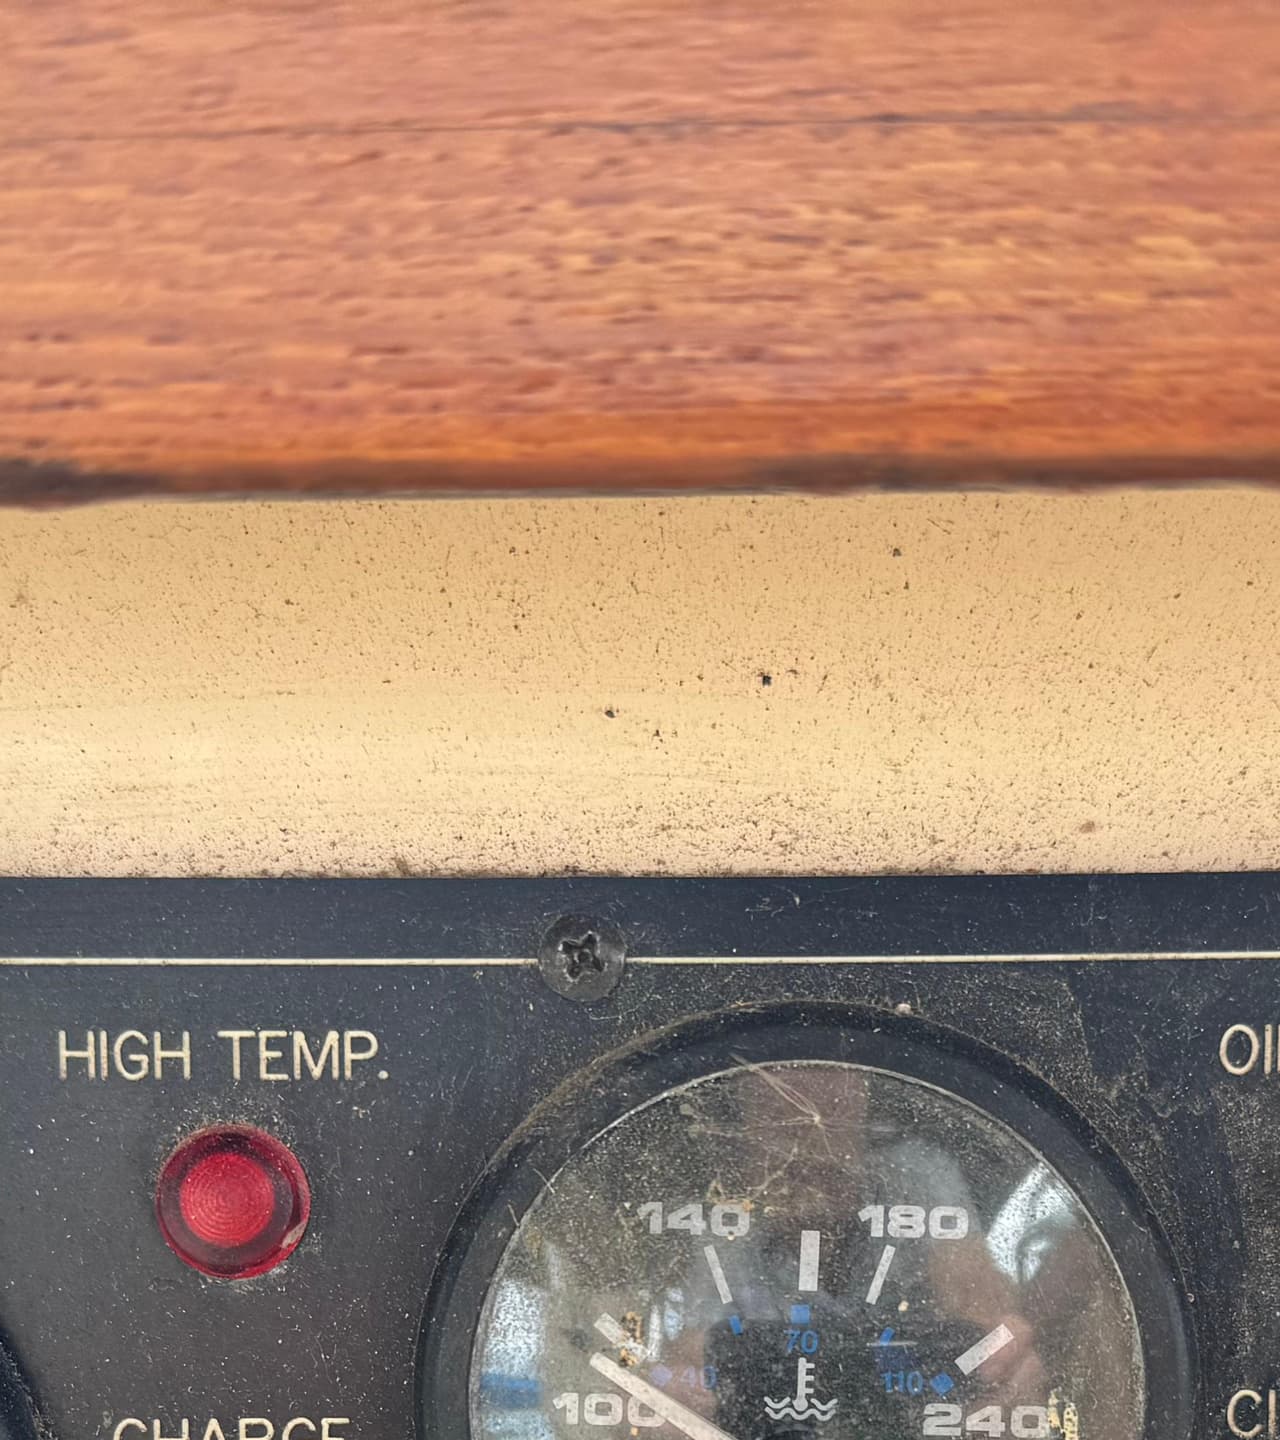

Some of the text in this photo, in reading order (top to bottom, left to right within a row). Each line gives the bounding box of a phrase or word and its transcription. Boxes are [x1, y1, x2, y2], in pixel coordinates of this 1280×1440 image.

[57, 1029, 390, 1081] HIGH TEMP.
[636, 1201, 751, 1237] 140
[858, 1204, 970, 1240] 180
[783, 1329, 819, 1355] 70
[678, 1365, 718, 1391] 40
[879, 1369, 924, 1396] 110
[922, 1402, 1051, 1439] 240
